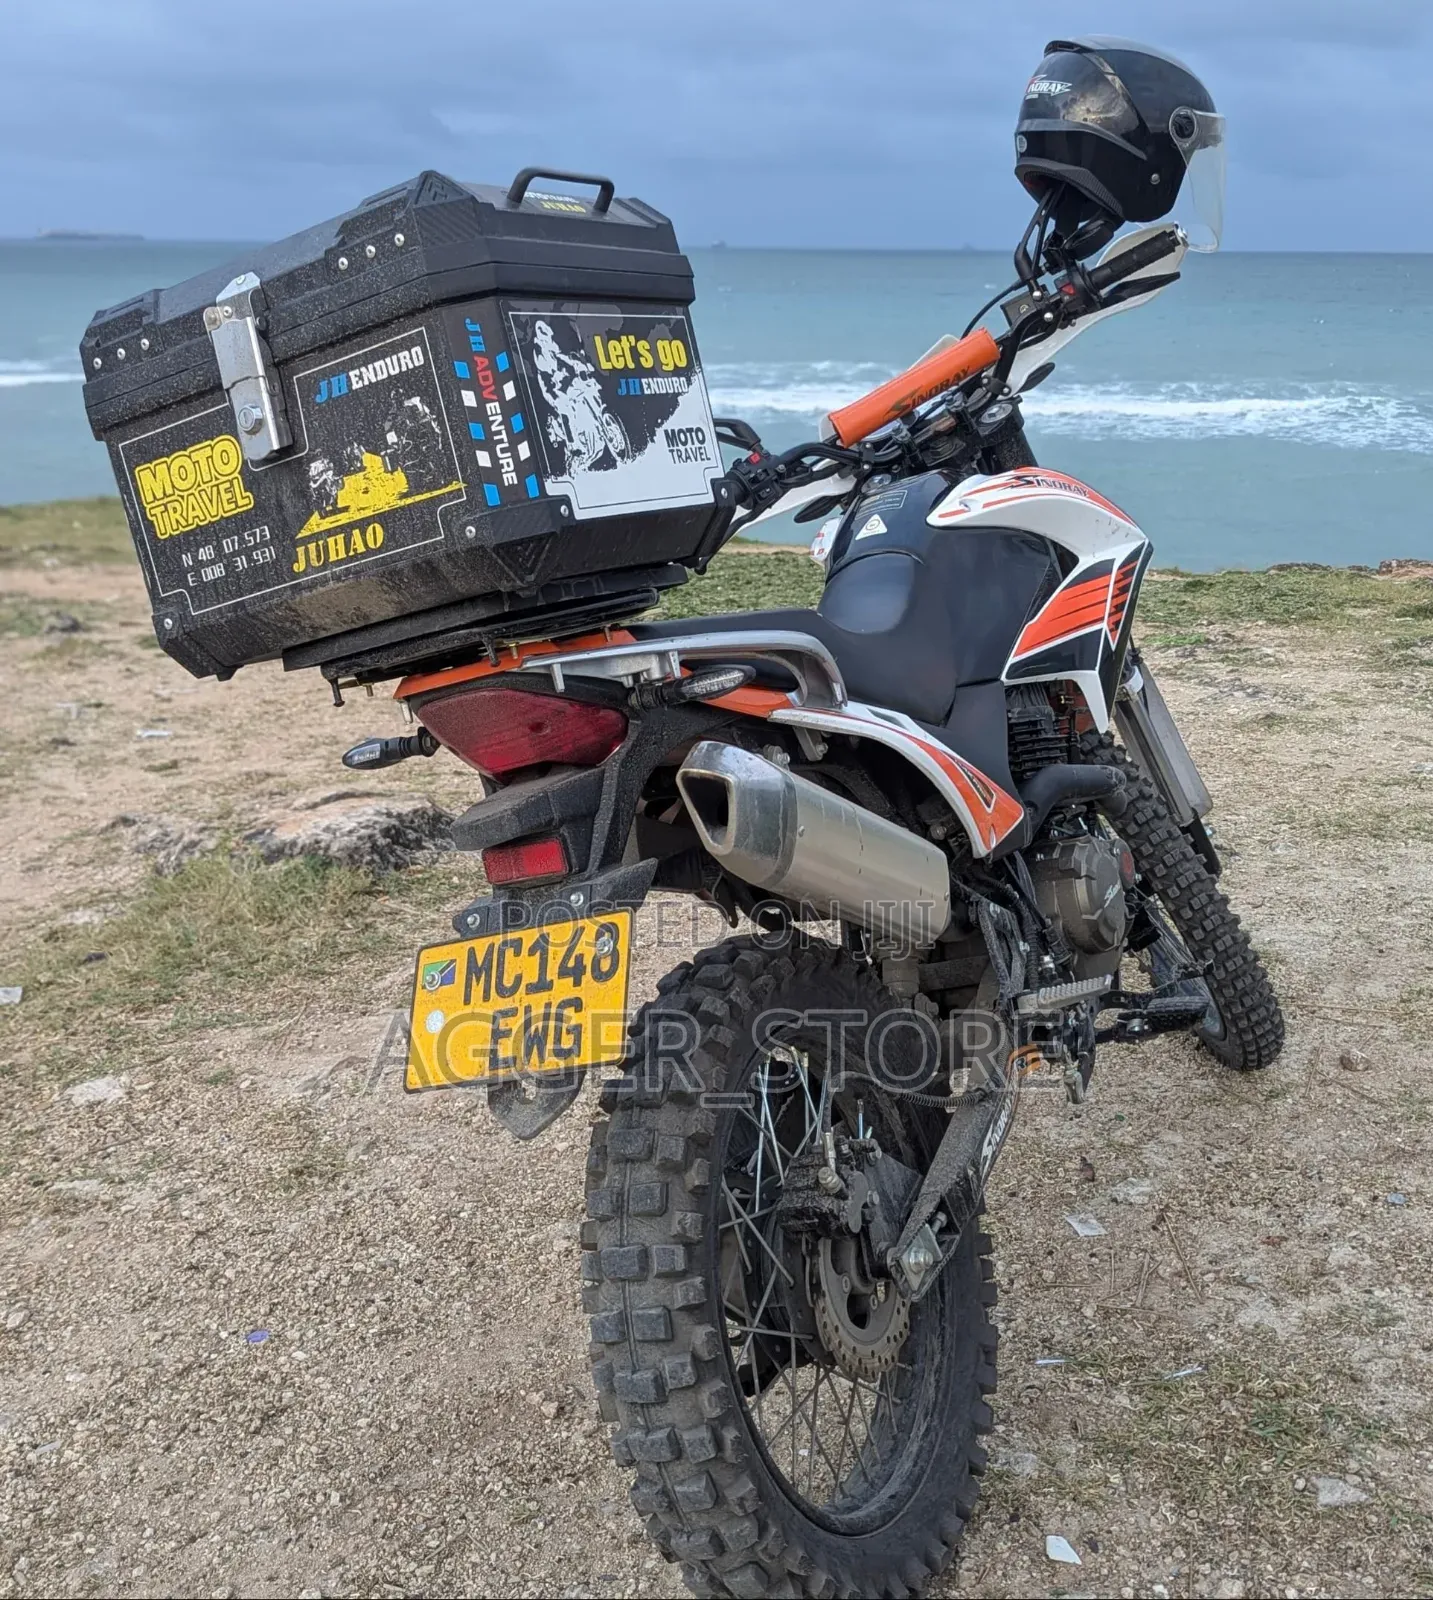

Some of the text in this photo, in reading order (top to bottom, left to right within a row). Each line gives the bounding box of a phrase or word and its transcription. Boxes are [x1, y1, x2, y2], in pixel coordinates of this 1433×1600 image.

[594, 335, 688, 371] Let's go
[473, 355, 518, 487] ADVENTURE
[664, 426, 706, 450] MOTO
[135, 435, 242, 506] MOTO
[668, 447, 712, 465] TRAVEL
[147, 478, 253, 540] TRAVEL
[1001, 475, 1089, 497] SINDRAY
[181, 552, 193, 568] N
[222, 525, 270, 554] 07.573
[187, 572, 198, 586] E
[232, 545, 276, 572] 31.931
[292, 523, 384, 573] JUHAO
[463, 921, 620, 1006] MC148
[488, 996, 584, 1071] EWG
